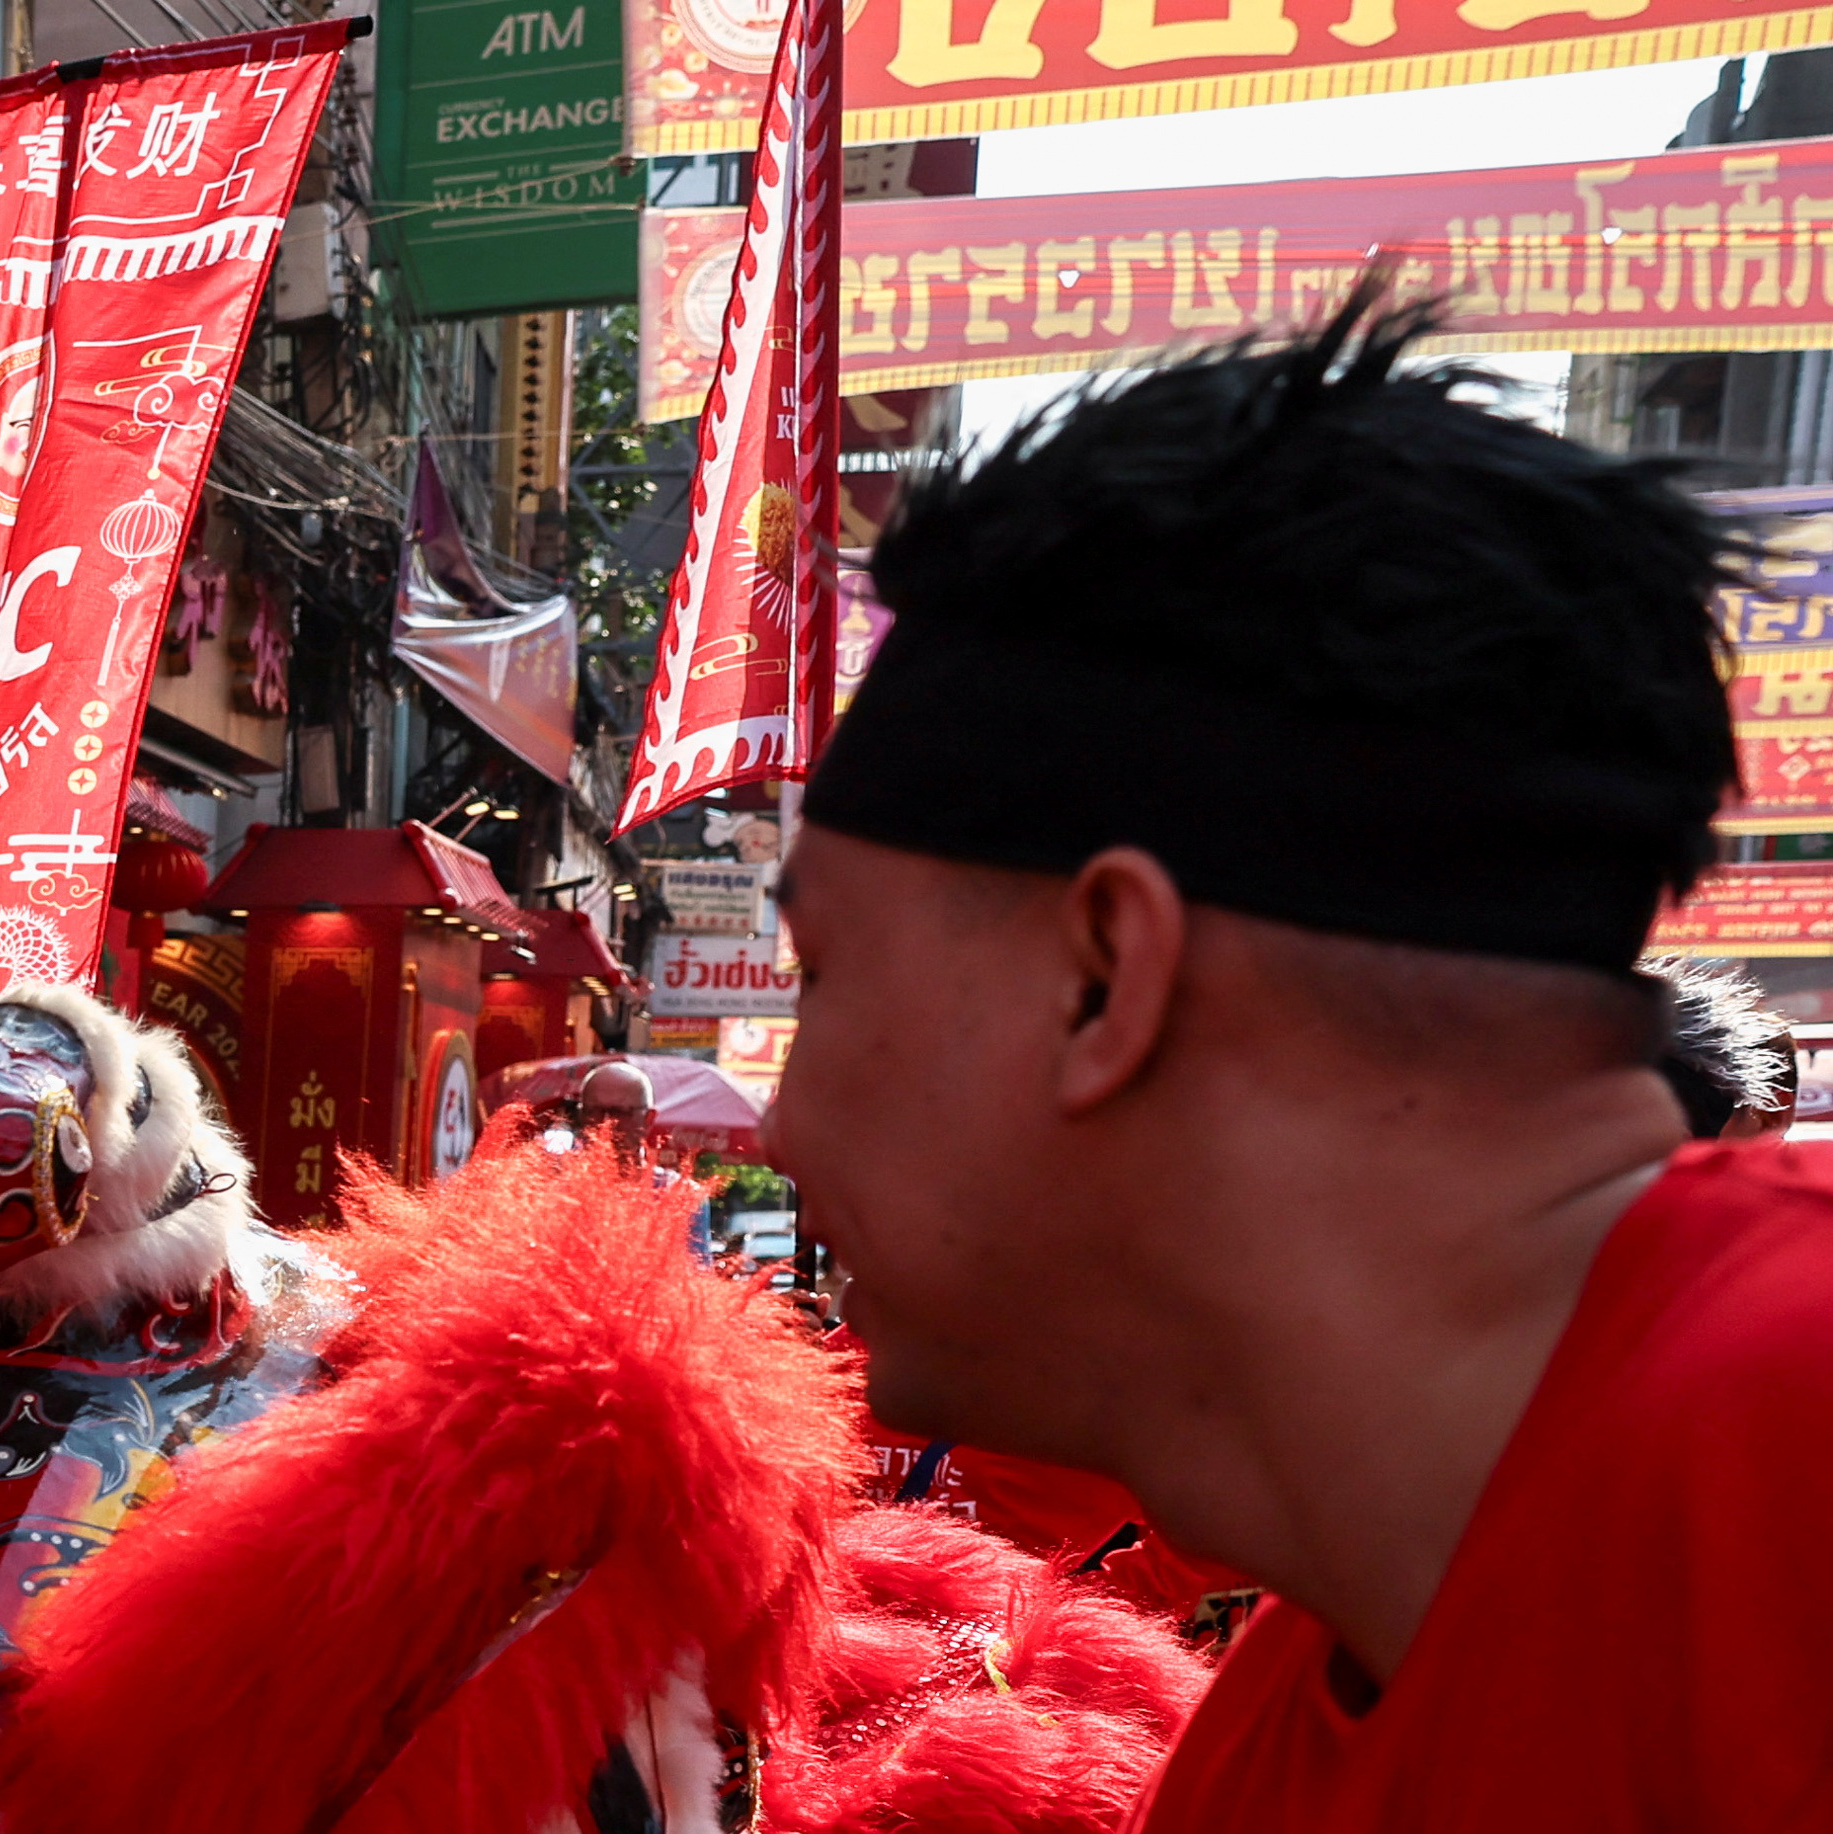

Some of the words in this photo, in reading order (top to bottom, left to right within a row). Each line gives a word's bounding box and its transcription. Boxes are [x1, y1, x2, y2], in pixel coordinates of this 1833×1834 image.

[481, 6, 585, 60] ATM
[434, 172, 616, 212] WISDOM
[506, 163, 542, 179] THE
[147, 978, 208, 1031] EAR
